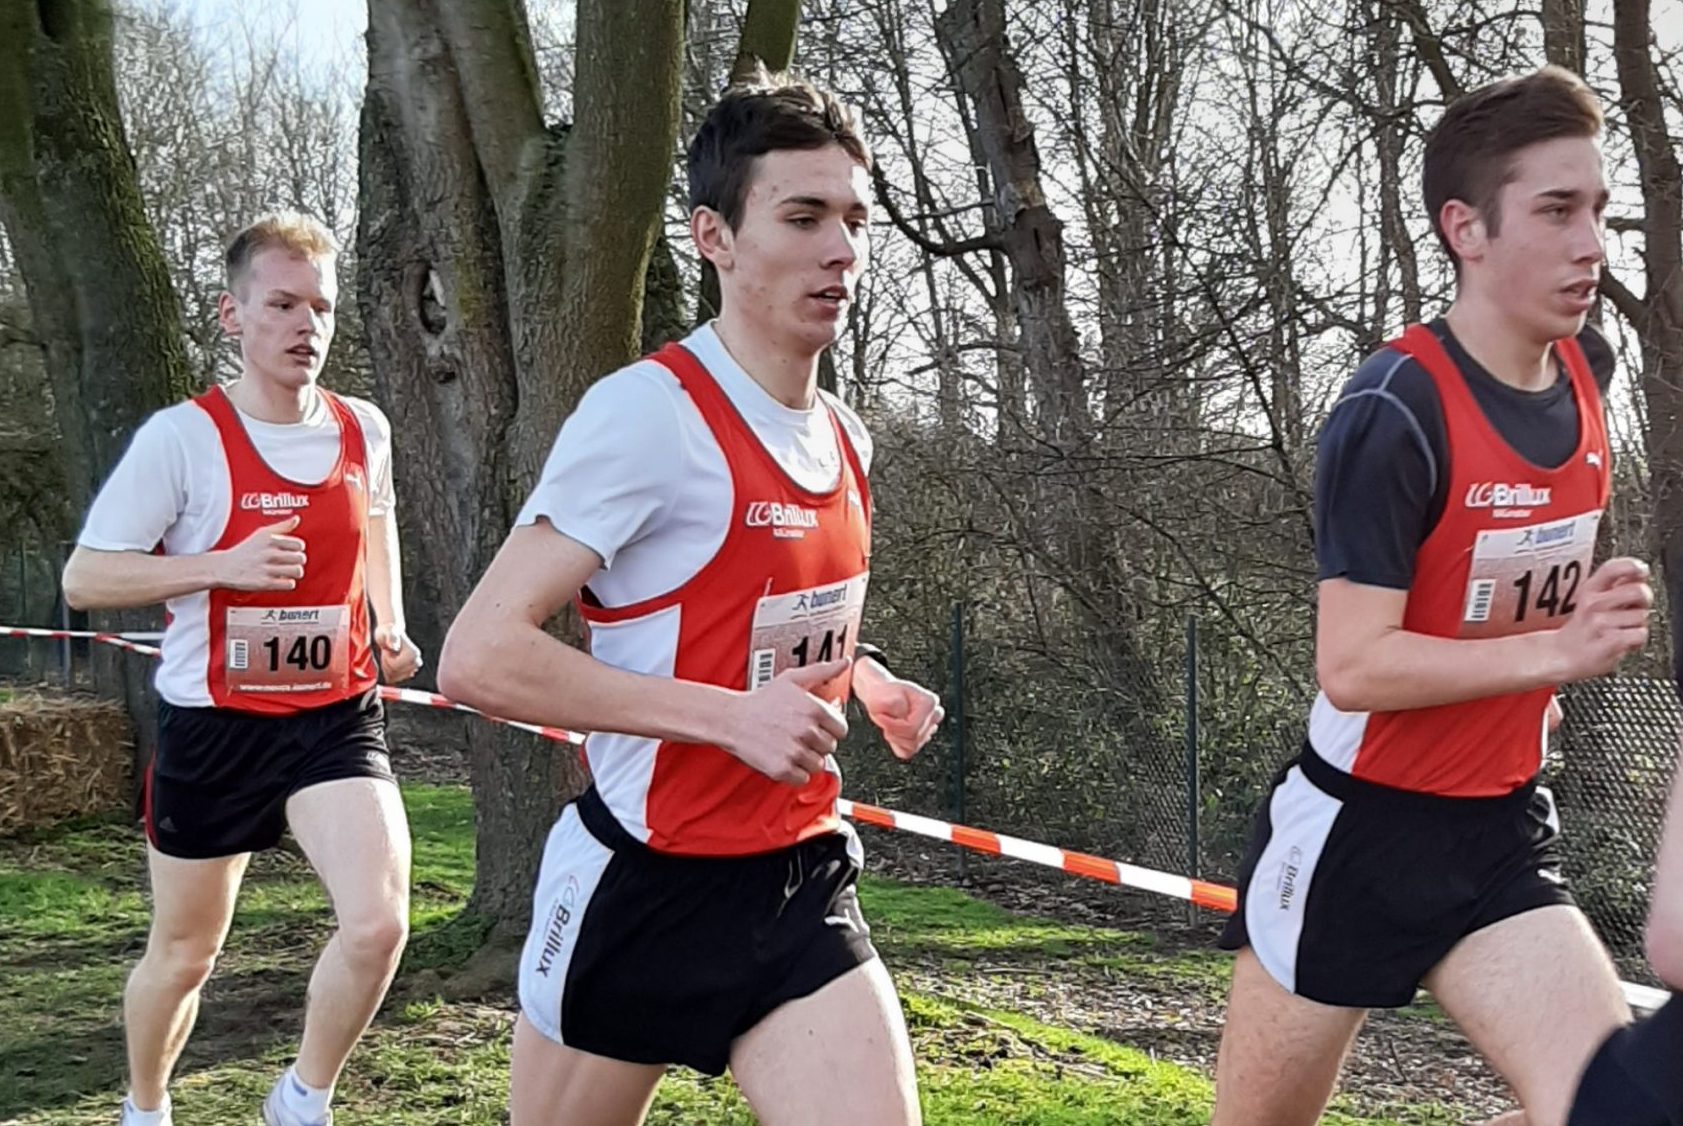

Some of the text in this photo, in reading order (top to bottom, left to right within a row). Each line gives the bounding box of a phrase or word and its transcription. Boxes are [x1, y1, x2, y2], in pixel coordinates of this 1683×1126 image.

[260, 492, 310, 509] Brillux
[1493, 483, 1552, 506] Brillux
[770, 502, 819, 528] Brillux
[1514, 560, 1581, 622] 142
[263, 635, 331, 671] 140
[792, 624, 848, 667] 141
[1279, 865, 1298, 910] Brillux
[536, 904, 570, 978] Brillux
